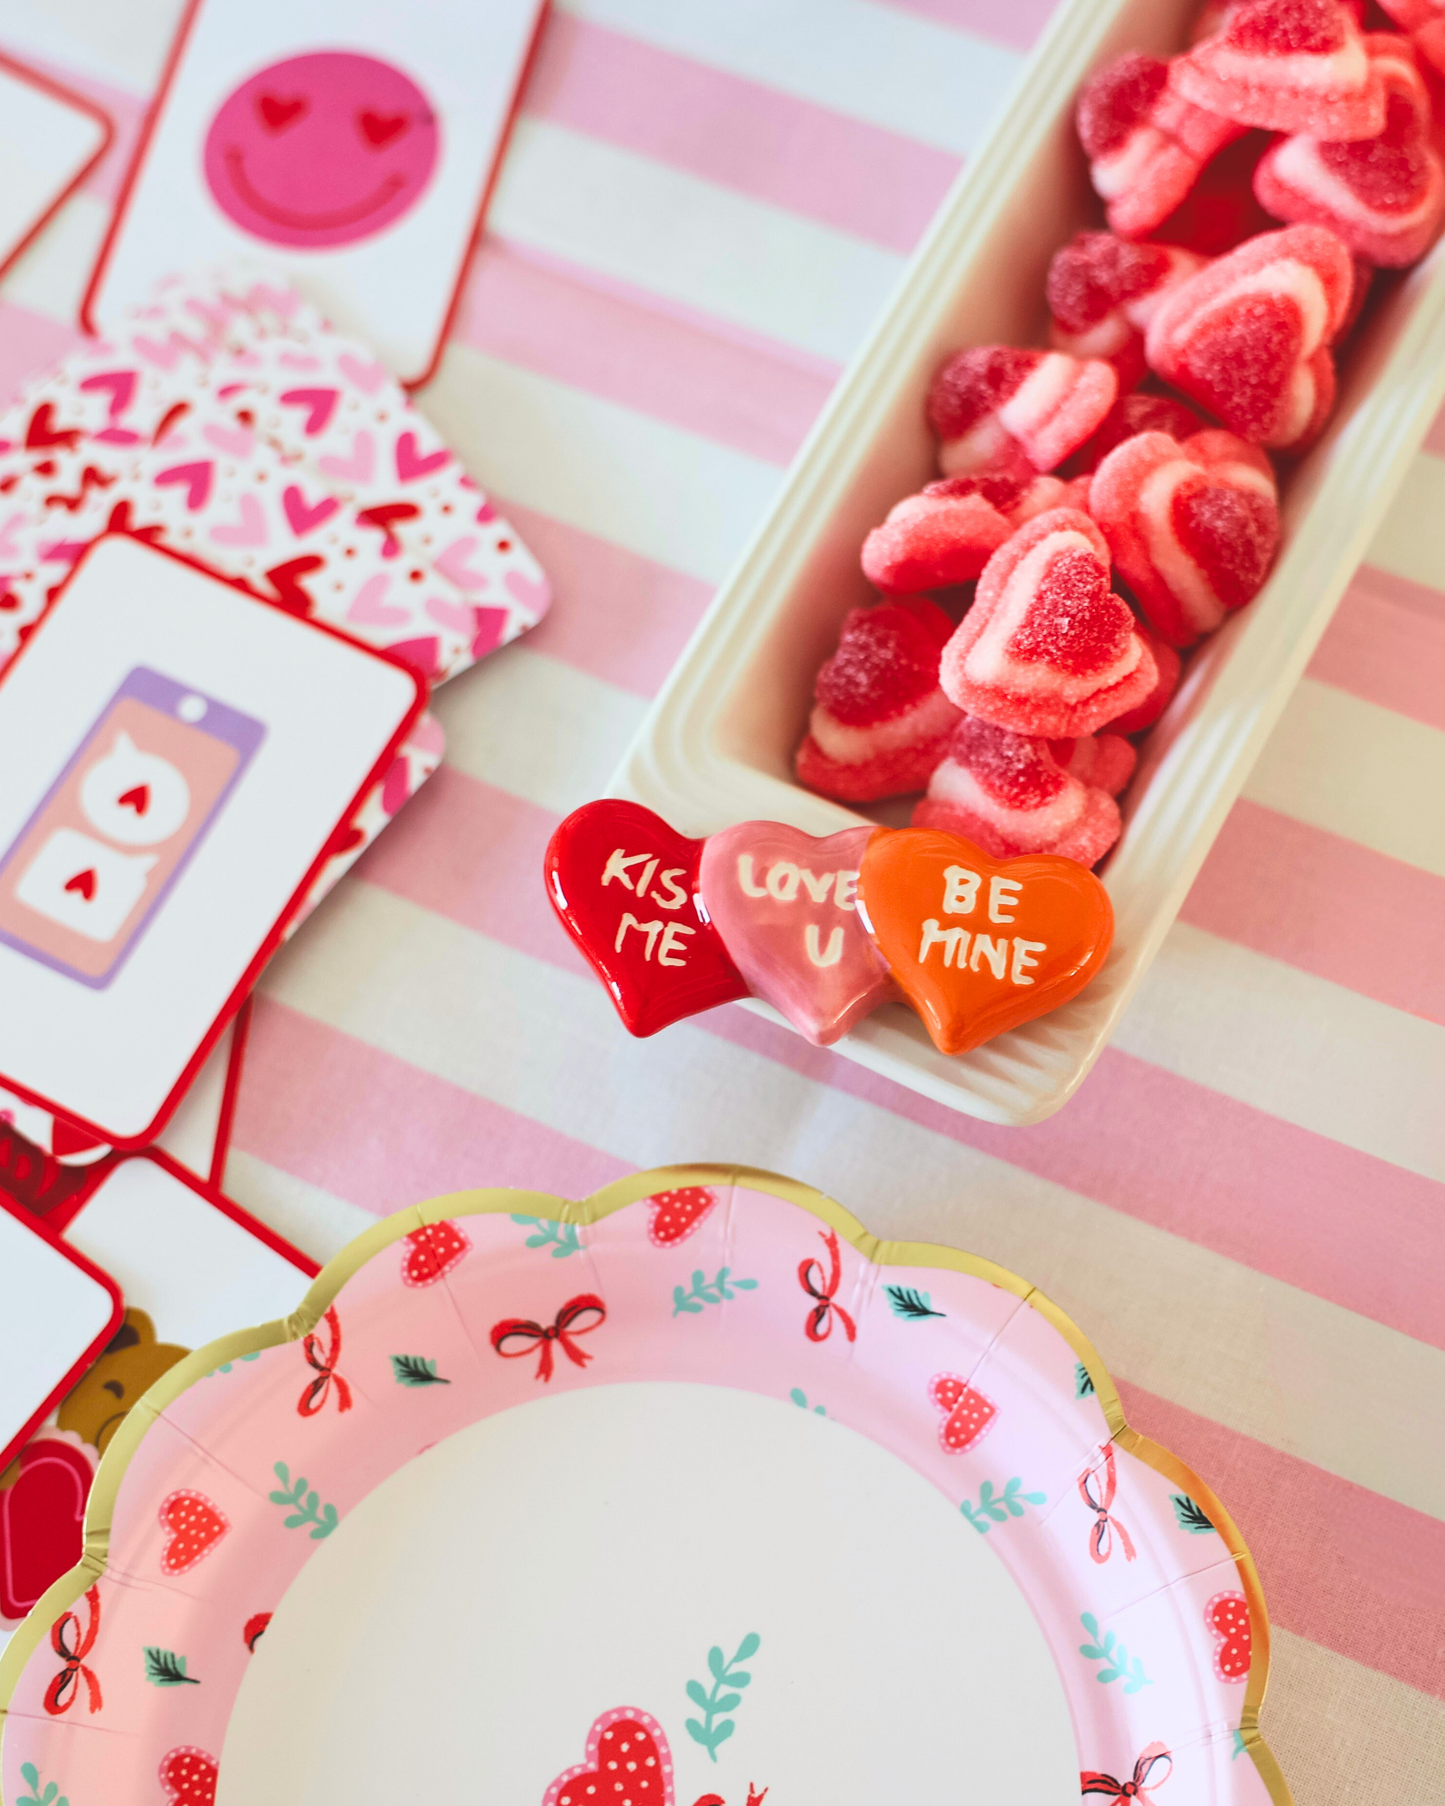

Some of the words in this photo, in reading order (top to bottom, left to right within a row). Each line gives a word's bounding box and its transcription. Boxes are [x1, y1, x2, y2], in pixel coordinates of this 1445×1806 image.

[601, 848, 688, 910] KIS
[737, 853, 861, 911] LOVE
[942, 865, 1023, 924] BE
[614, 912, 697, 967] ME
[804, 923, 845, 968] U
[918, 918, 1047, 985] MINE
